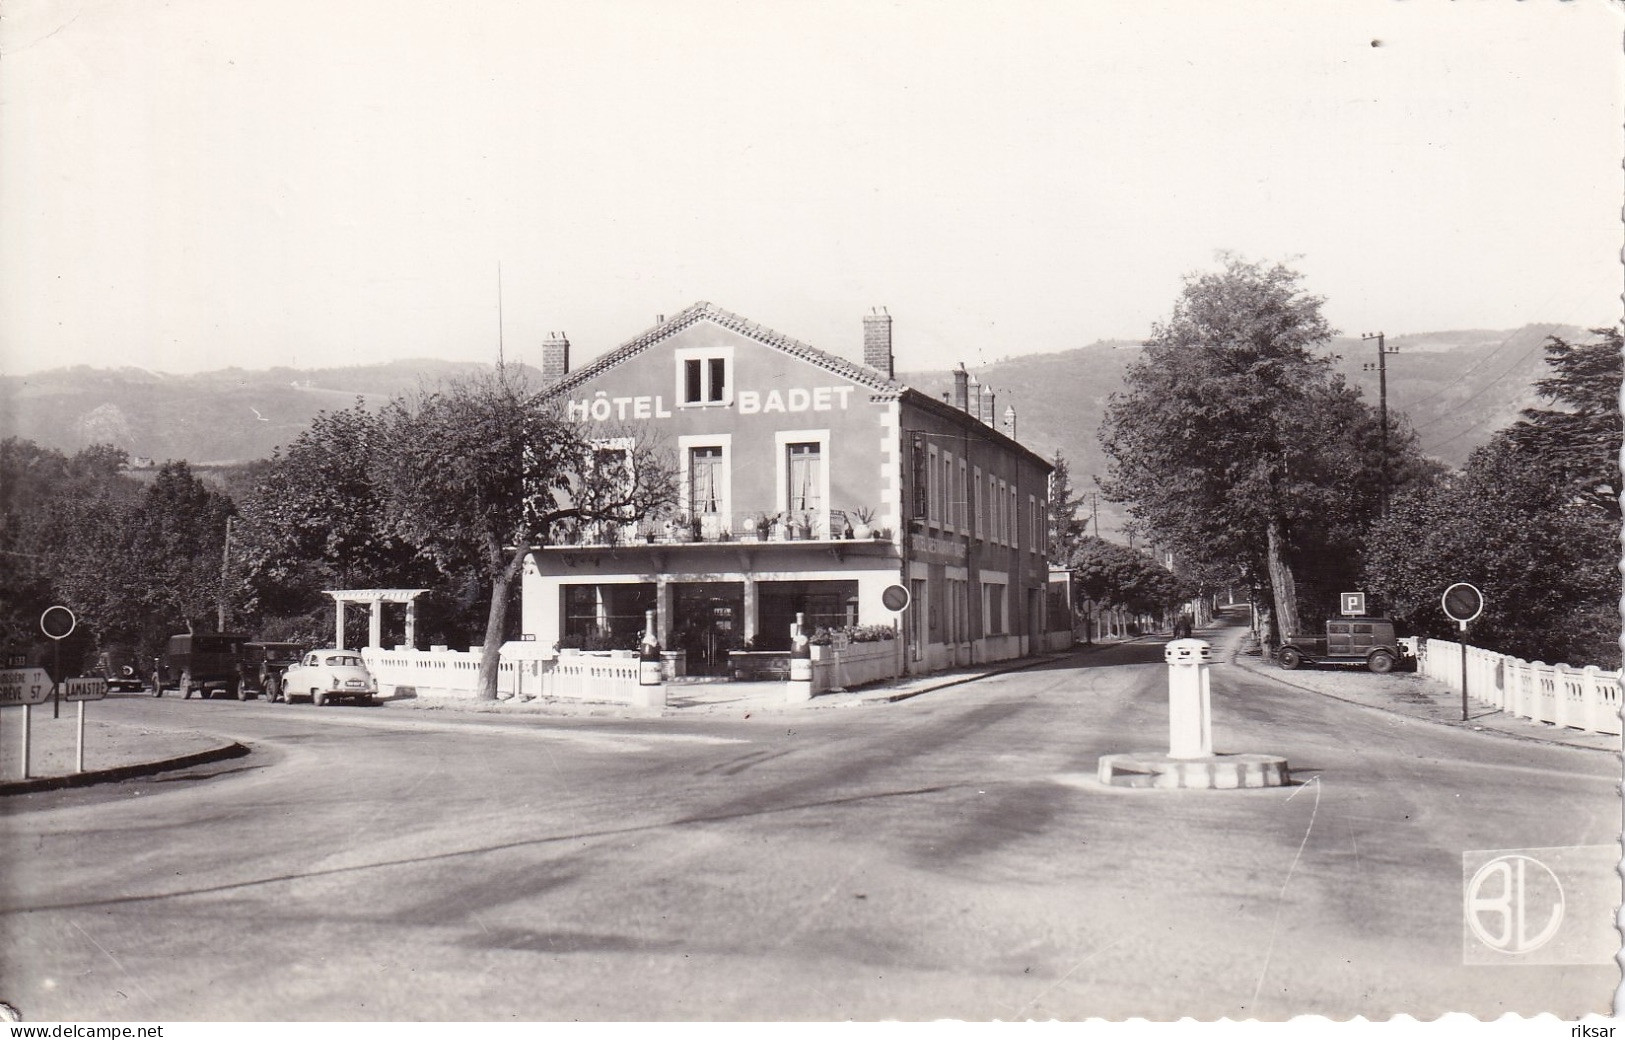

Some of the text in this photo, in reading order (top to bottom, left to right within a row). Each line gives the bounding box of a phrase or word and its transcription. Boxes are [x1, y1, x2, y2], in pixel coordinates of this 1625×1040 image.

[568, 386, 855, 423] HÔTEL BADET
[1347, 596, 1359, 611] P
[33, 672, 42, 683] 17
[30, 685, 42, 699] 57
[66, 681, 106, 698] LAMASTRE
